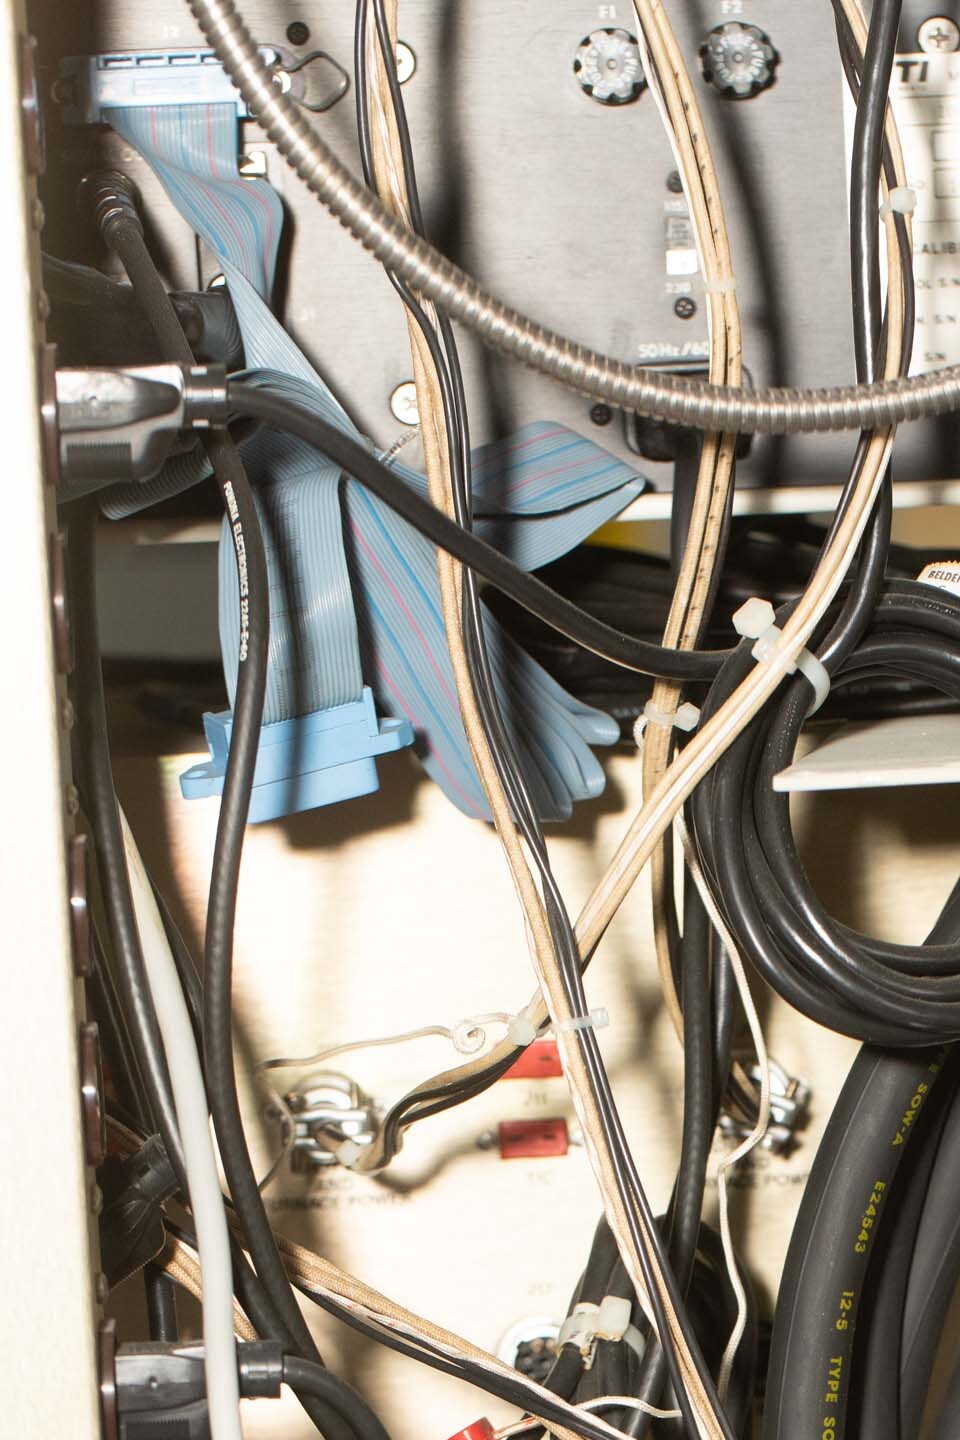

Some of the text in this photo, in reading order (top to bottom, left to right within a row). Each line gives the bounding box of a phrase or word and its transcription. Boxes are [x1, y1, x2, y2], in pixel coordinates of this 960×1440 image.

[599, 5, 617, 19] F1
[892, 1082, 929, 1147] SOW-A
[854, 1180, 888, 1254] E24543
[836, 1290, 855, 1331] 12-5
[824, 1356, 843, 1403] TYPE
